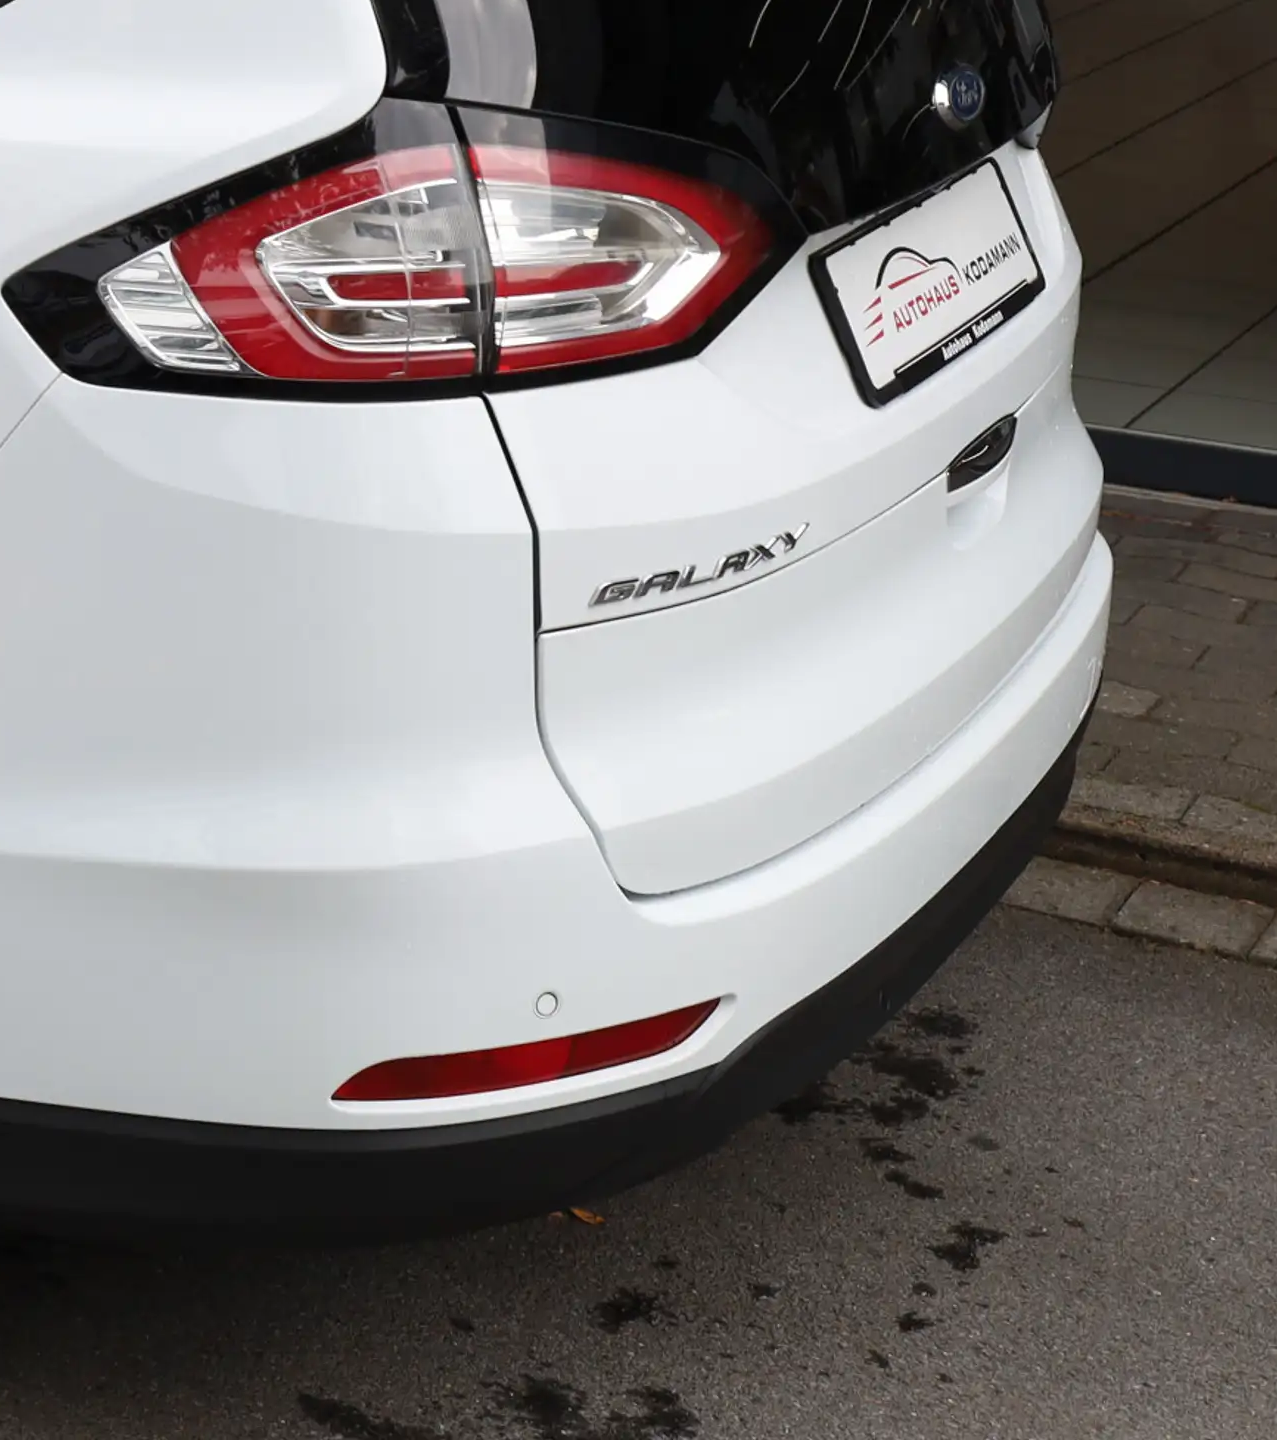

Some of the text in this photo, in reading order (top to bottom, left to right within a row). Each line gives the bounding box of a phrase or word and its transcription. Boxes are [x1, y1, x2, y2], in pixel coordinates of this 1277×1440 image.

[892, 233, 1021, 332] AUTOHAUS KODAMANN
[941, 311, 1005, 361] Autohaus Kodamann
[587, 521, 810, 609] GALAXY
